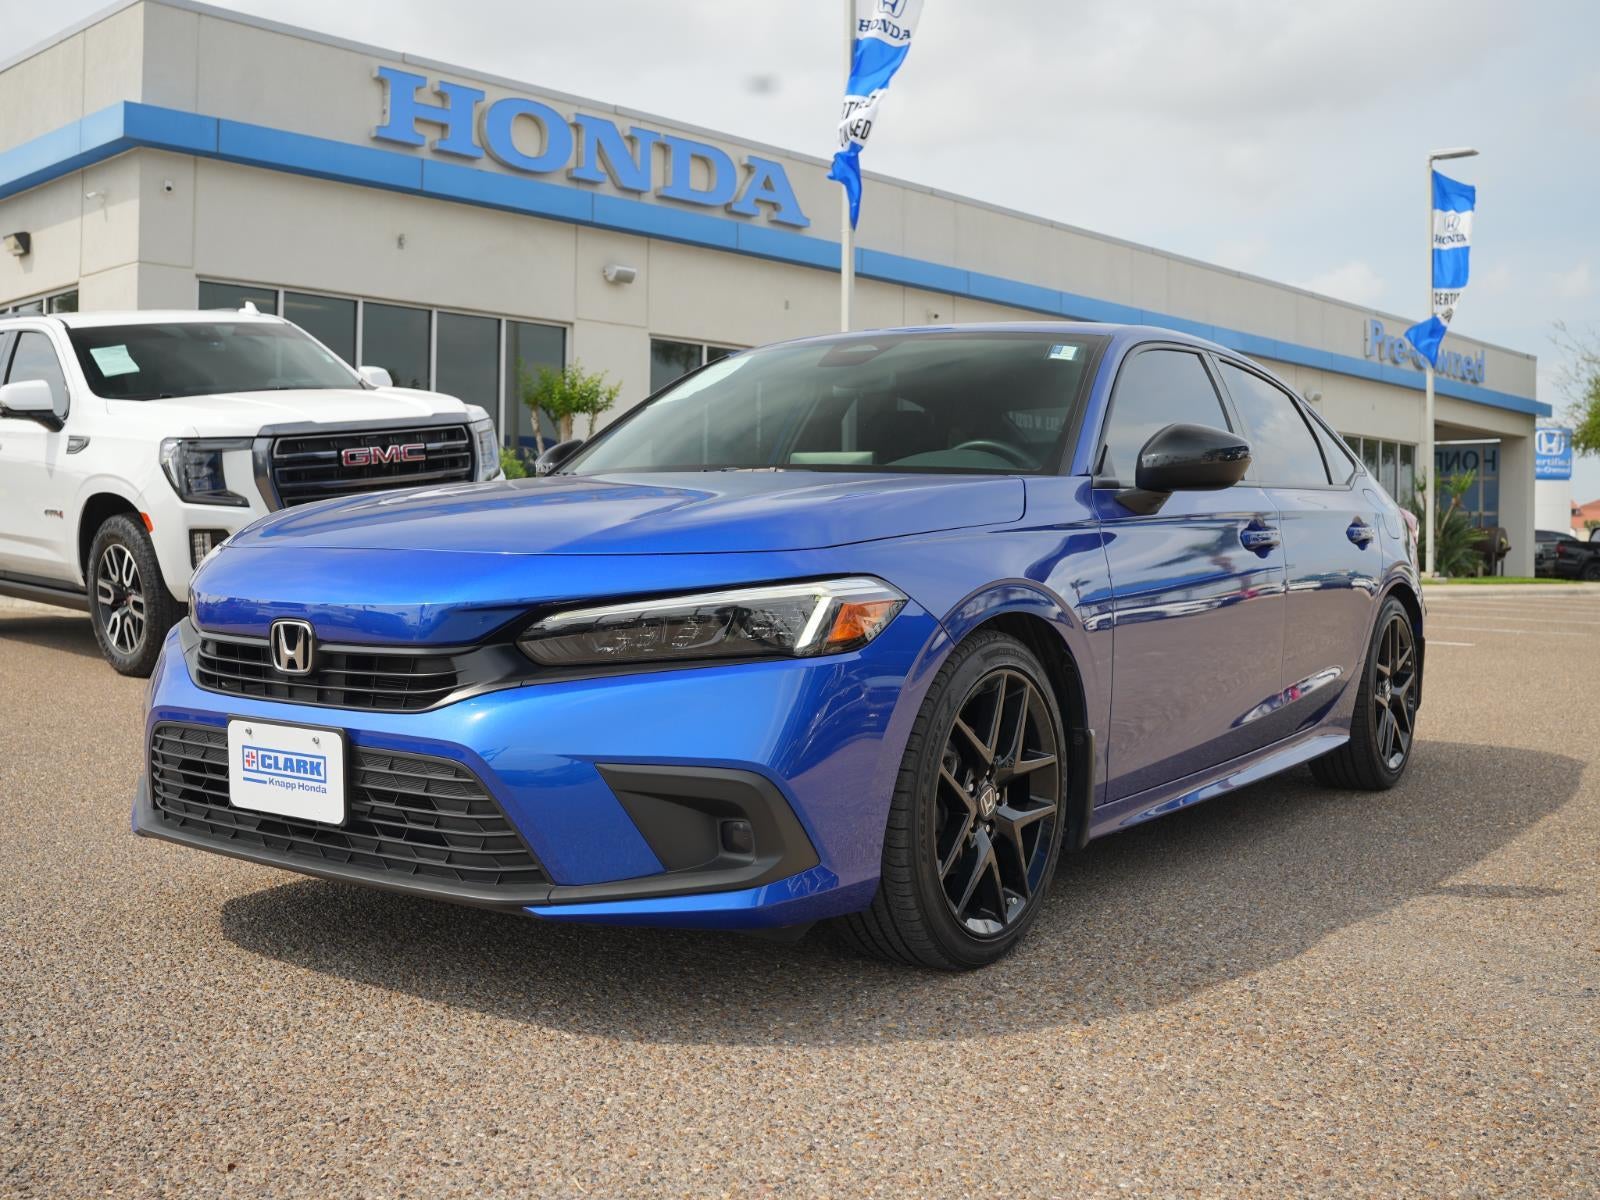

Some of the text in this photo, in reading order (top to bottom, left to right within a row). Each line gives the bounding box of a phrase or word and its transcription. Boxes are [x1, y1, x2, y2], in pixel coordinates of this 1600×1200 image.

[858, 18, 912, 41] HONDA
[371, 65, 810, 228] HONDA
[1364, 318, 1486, 385] Pre-wned
[341, 442, 426, 467] GMC
[260, 754, 322, 777] CLARK
[268, 777, 327, 794] Knapp Honda
